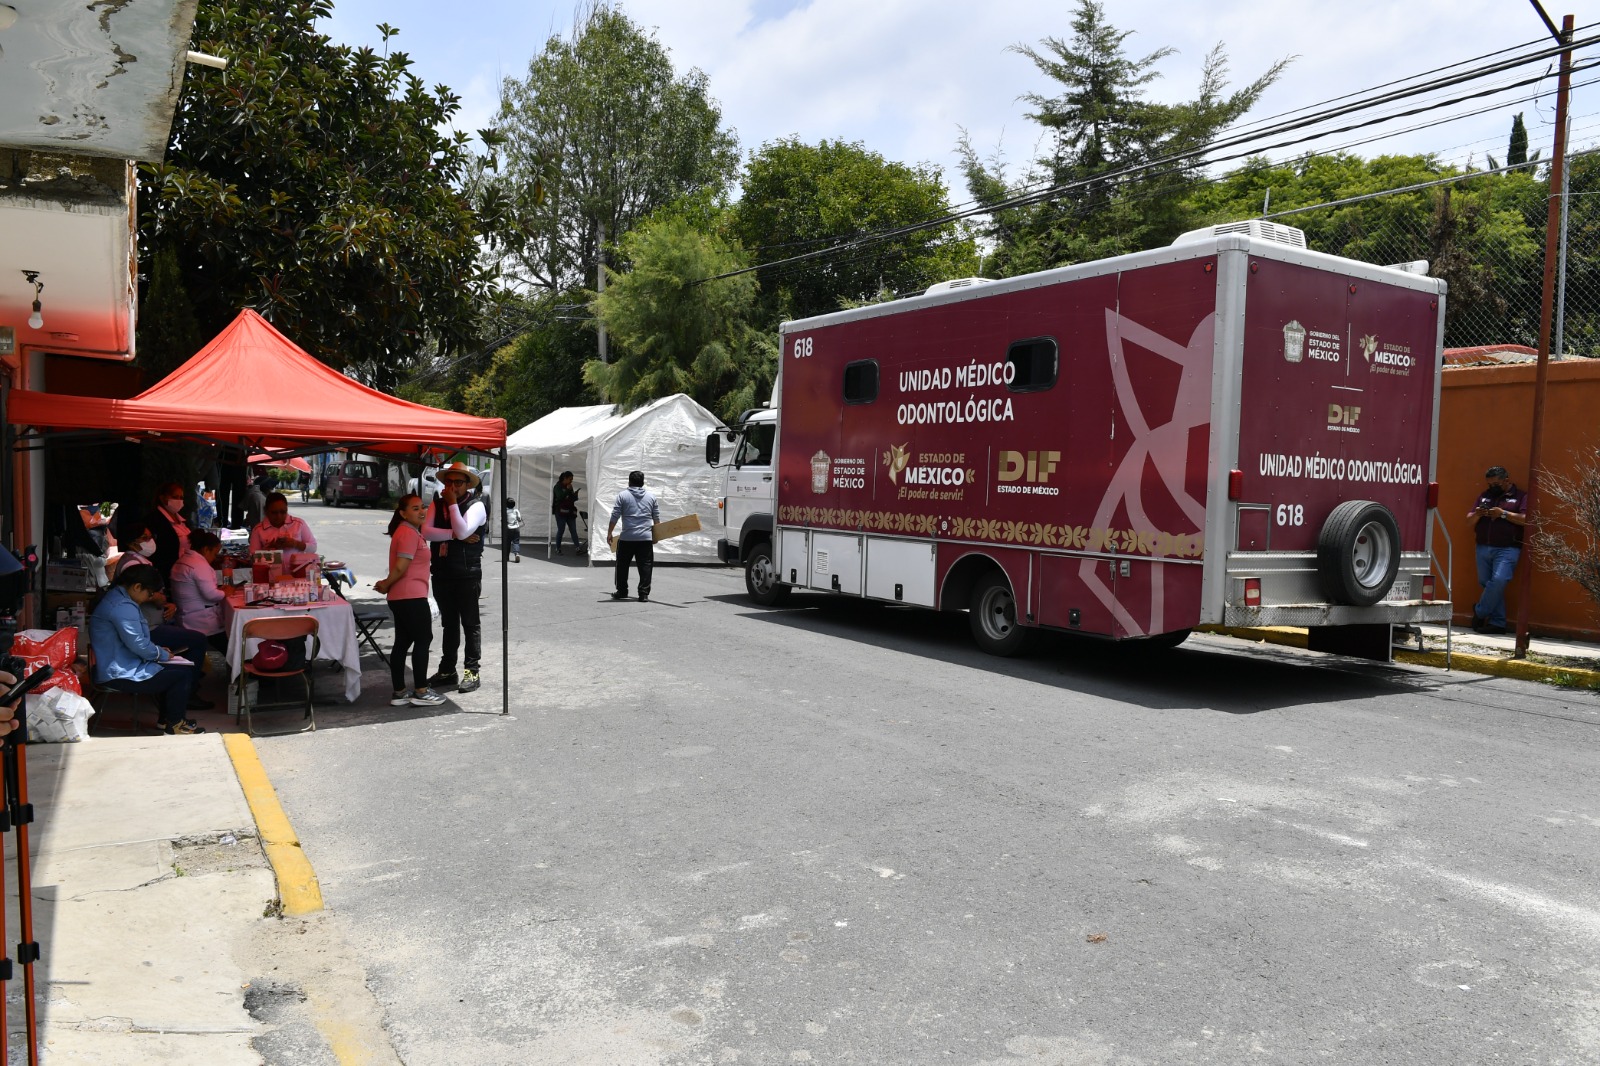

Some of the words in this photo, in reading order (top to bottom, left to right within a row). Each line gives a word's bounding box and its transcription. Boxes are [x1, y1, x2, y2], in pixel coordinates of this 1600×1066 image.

[1310, 330, 1331, 338] GOBIERNO
[794, 338, 813, 358] 618
[1309, 339, 1331, 348] ESTADO
[1384, 343, 1403, 352] ESTADO
[1309, 347, 1339, 362] MÉXICO
[1375, 350, 1410, 366] MÉXICO
[899, 366, 951, 392] UNIDAD
[956, 359, 1015, 388] MÉDICO
[1376, 366, 1390, 374] poder
[898, 394, 1014, 425] ODONTOLÓGICA
[1327, 404, 1361, 426] DIF
[919, 453, 952, 463] ESTADO
[954, 454, 965, 463] DE
[998, 451, 1061, 482] DIF
[1260, 453, 1302, 478] UNIDAD
[1305, 451, 1344, 480] MÉDICO
[1348, 458, 1422, 485] ODONTOLÓGICA
[833, 475, 864, 489] MÉXICO
[905, 465, 964, 485] MÉXICO
[908, 487, 929, 500] poder
[930, 489, 939, 499] de
[940, 490, 963, 500] servir!
[997, 485, 1021, 493] ESTADO
[1032, 486, 1059, 496] MÉXICO
[1276, 504, 1304, 526] 618
